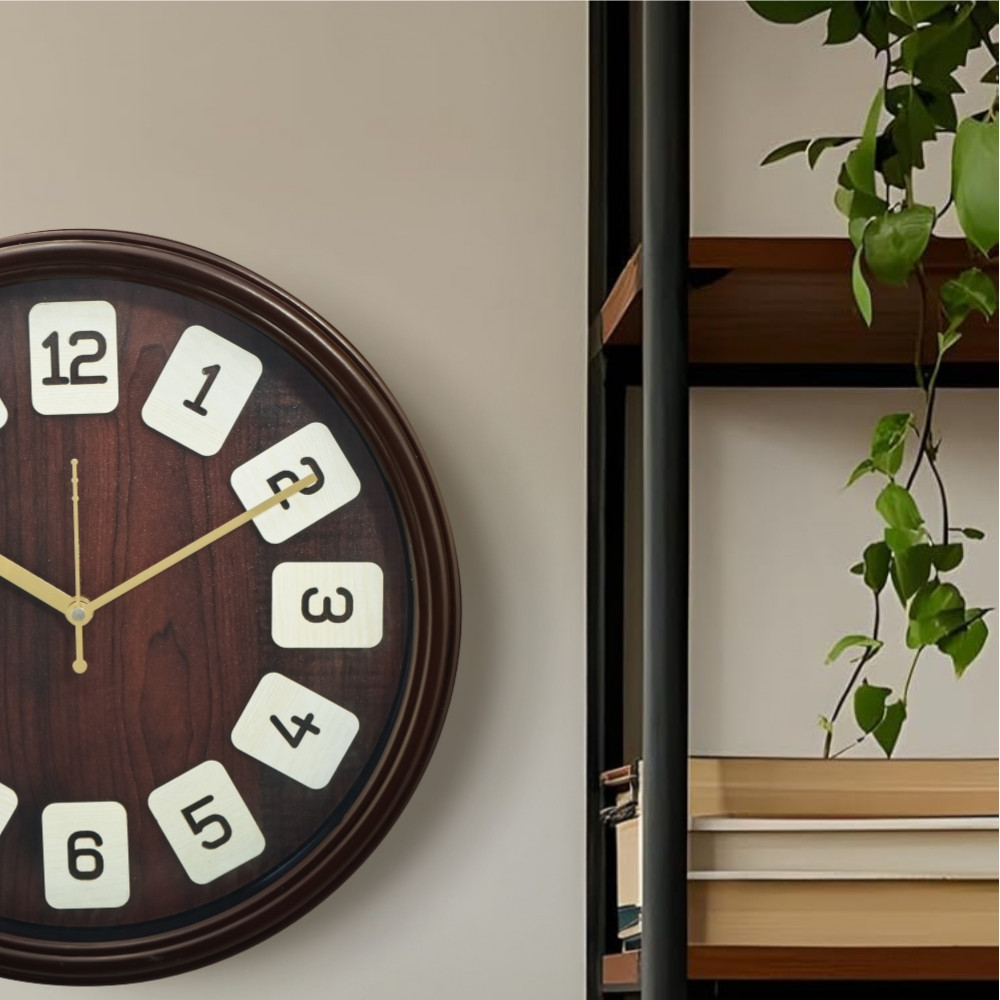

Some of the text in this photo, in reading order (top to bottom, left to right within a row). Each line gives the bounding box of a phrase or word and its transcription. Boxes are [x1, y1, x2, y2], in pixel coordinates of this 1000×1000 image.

[41, 330, 109, 387] 12
[182, 364, 222, 418] 1
[266, 456, 325, 511] 2
[301, 586, 355, 625] 3
[269, 712, 322, 750] 4
[180, 794, 234, 851] 5
[67, 830, 106, 882] 6
